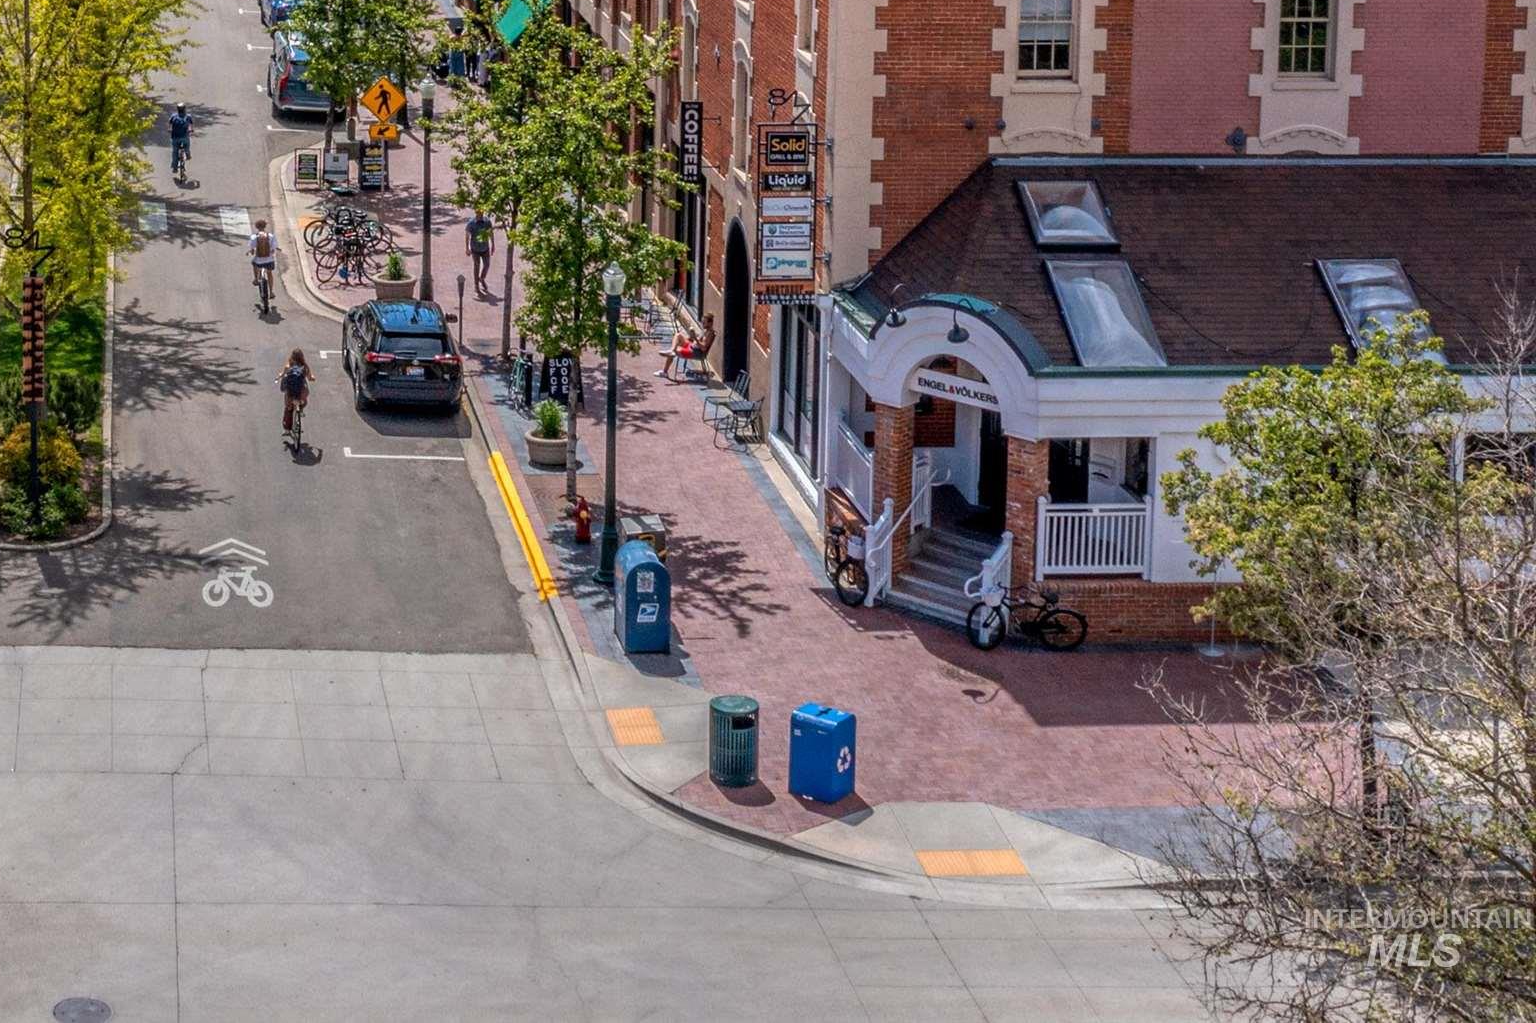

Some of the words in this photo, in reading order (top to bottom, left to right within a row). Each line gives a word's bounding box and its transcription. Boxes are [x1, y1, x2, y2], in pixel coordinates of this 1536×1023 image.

[684, 109, 699, 175] COFFEE
[771, 138, 805, 152] Solid
[768, 174, 806, 187] Liquid
